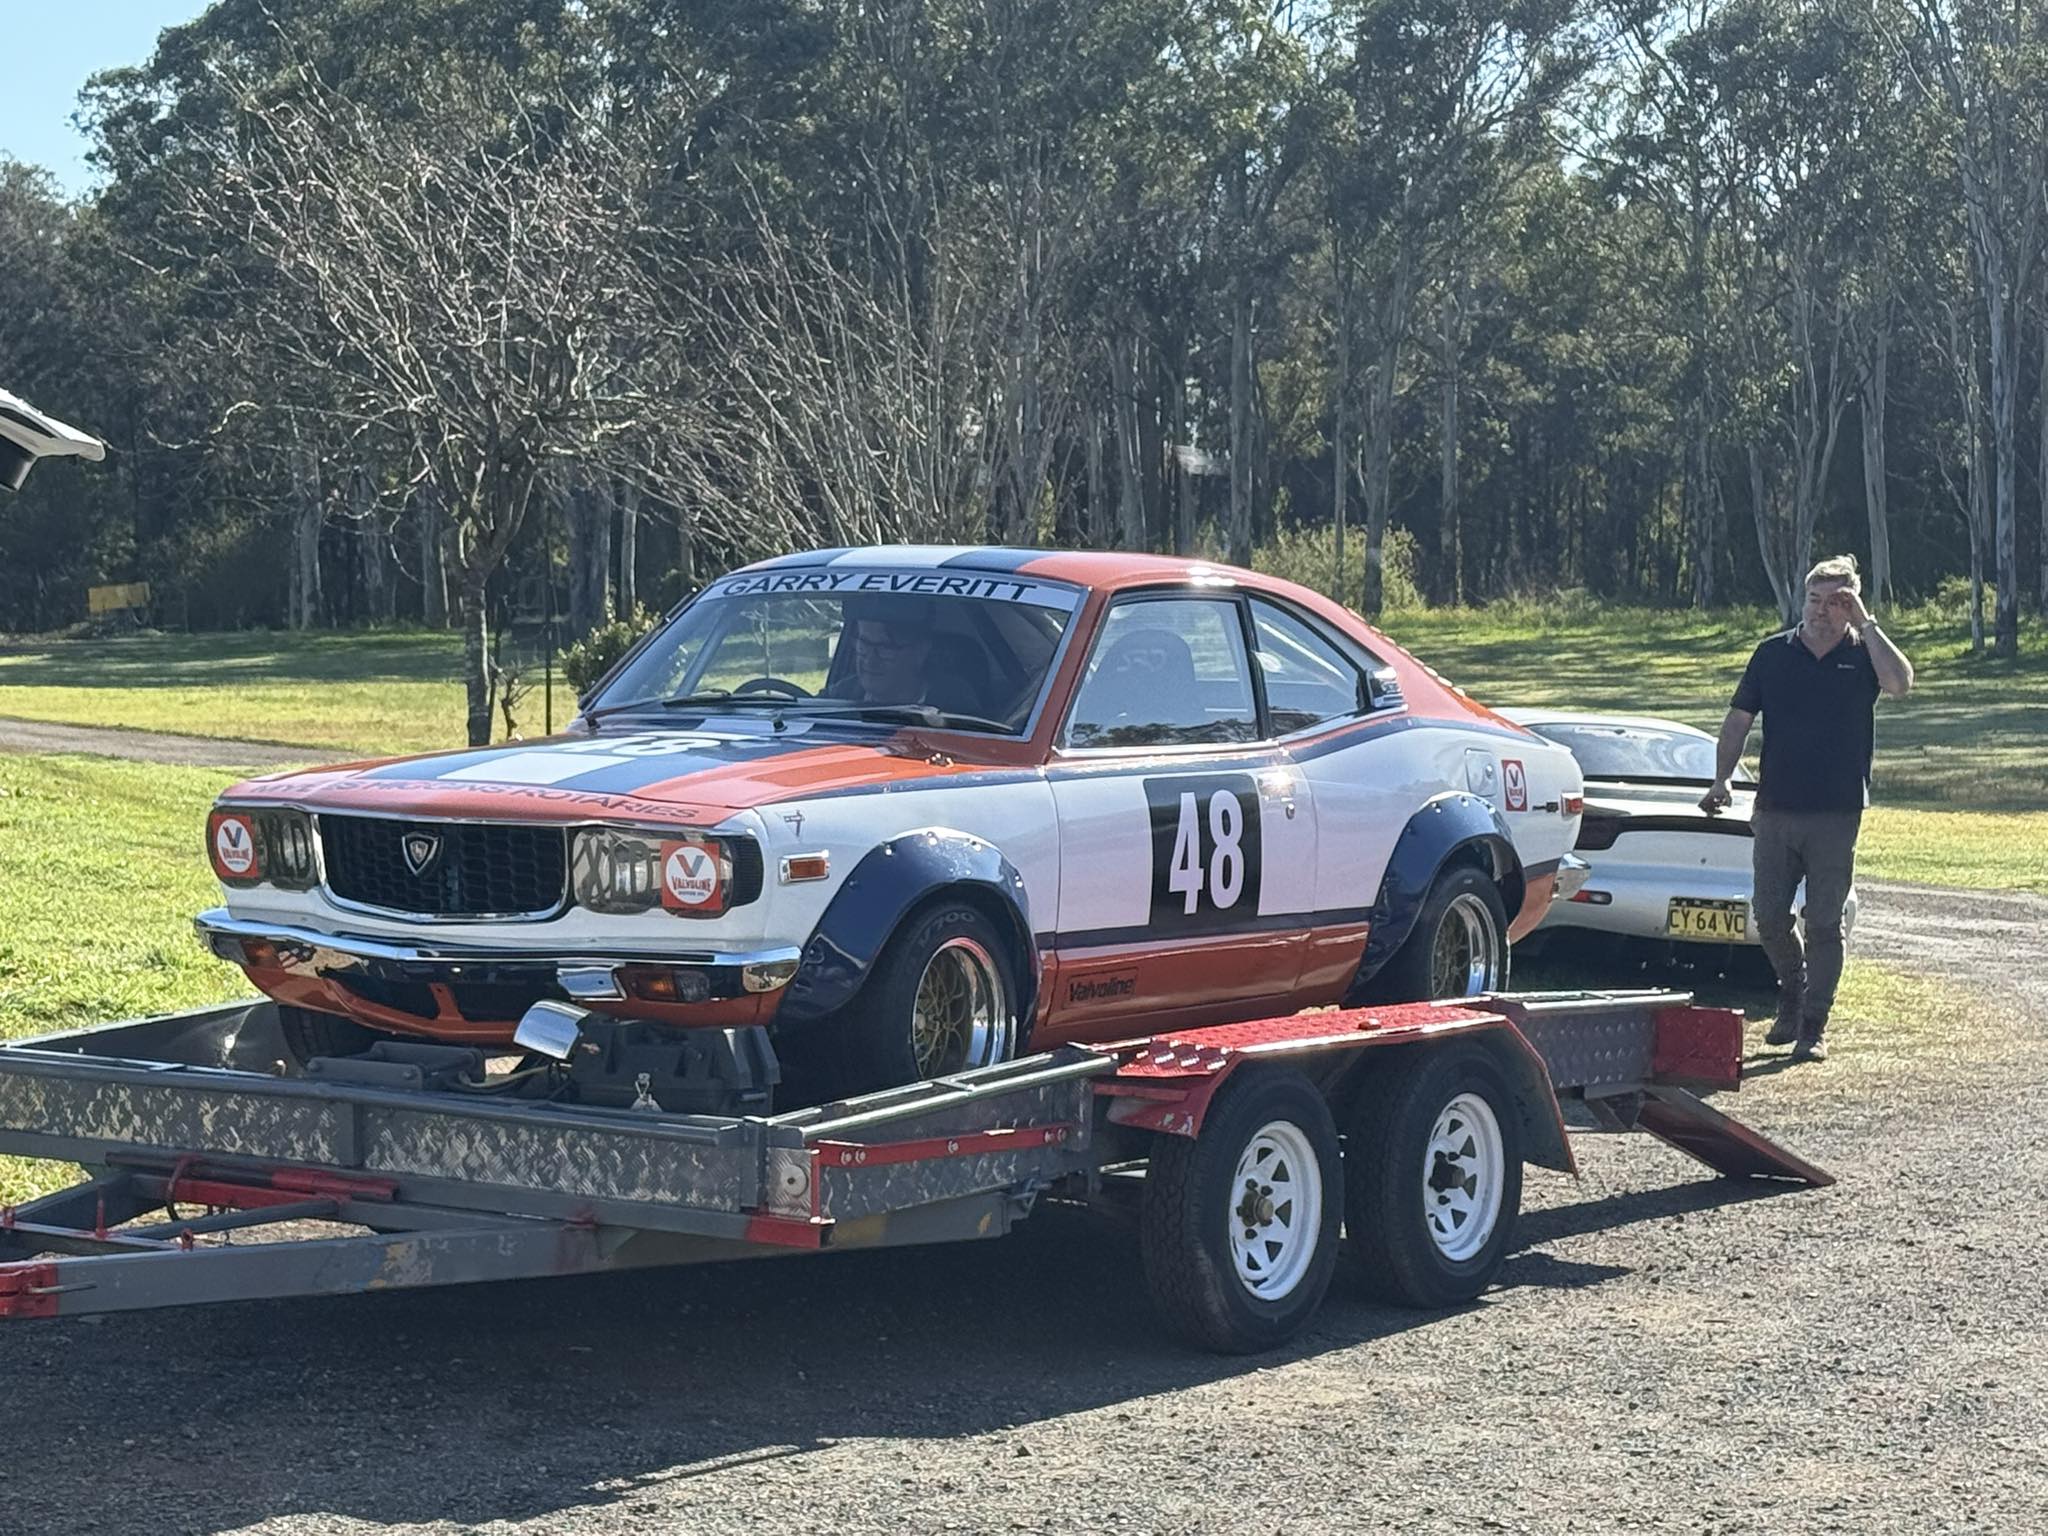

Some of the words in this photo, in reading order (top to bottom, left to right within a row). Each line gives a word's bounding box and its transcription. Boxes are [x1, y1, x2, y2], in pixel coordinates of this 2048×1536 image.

[722, 573, 855, 596] GARRY
[858, 573, 1037, 600] EVERITT
[509, 787, 700, 818] ROTARIES
[1169, 789, 1245, 915] 48
[671, 875, 712, 892] VALVOLINE
[1670, 909, 1690, 929] CY
[1696, 911, 1718, 932] 64
[1723, 912, 1745, 934] VC
[1069, 977, 1135, 1001] Valvoline
